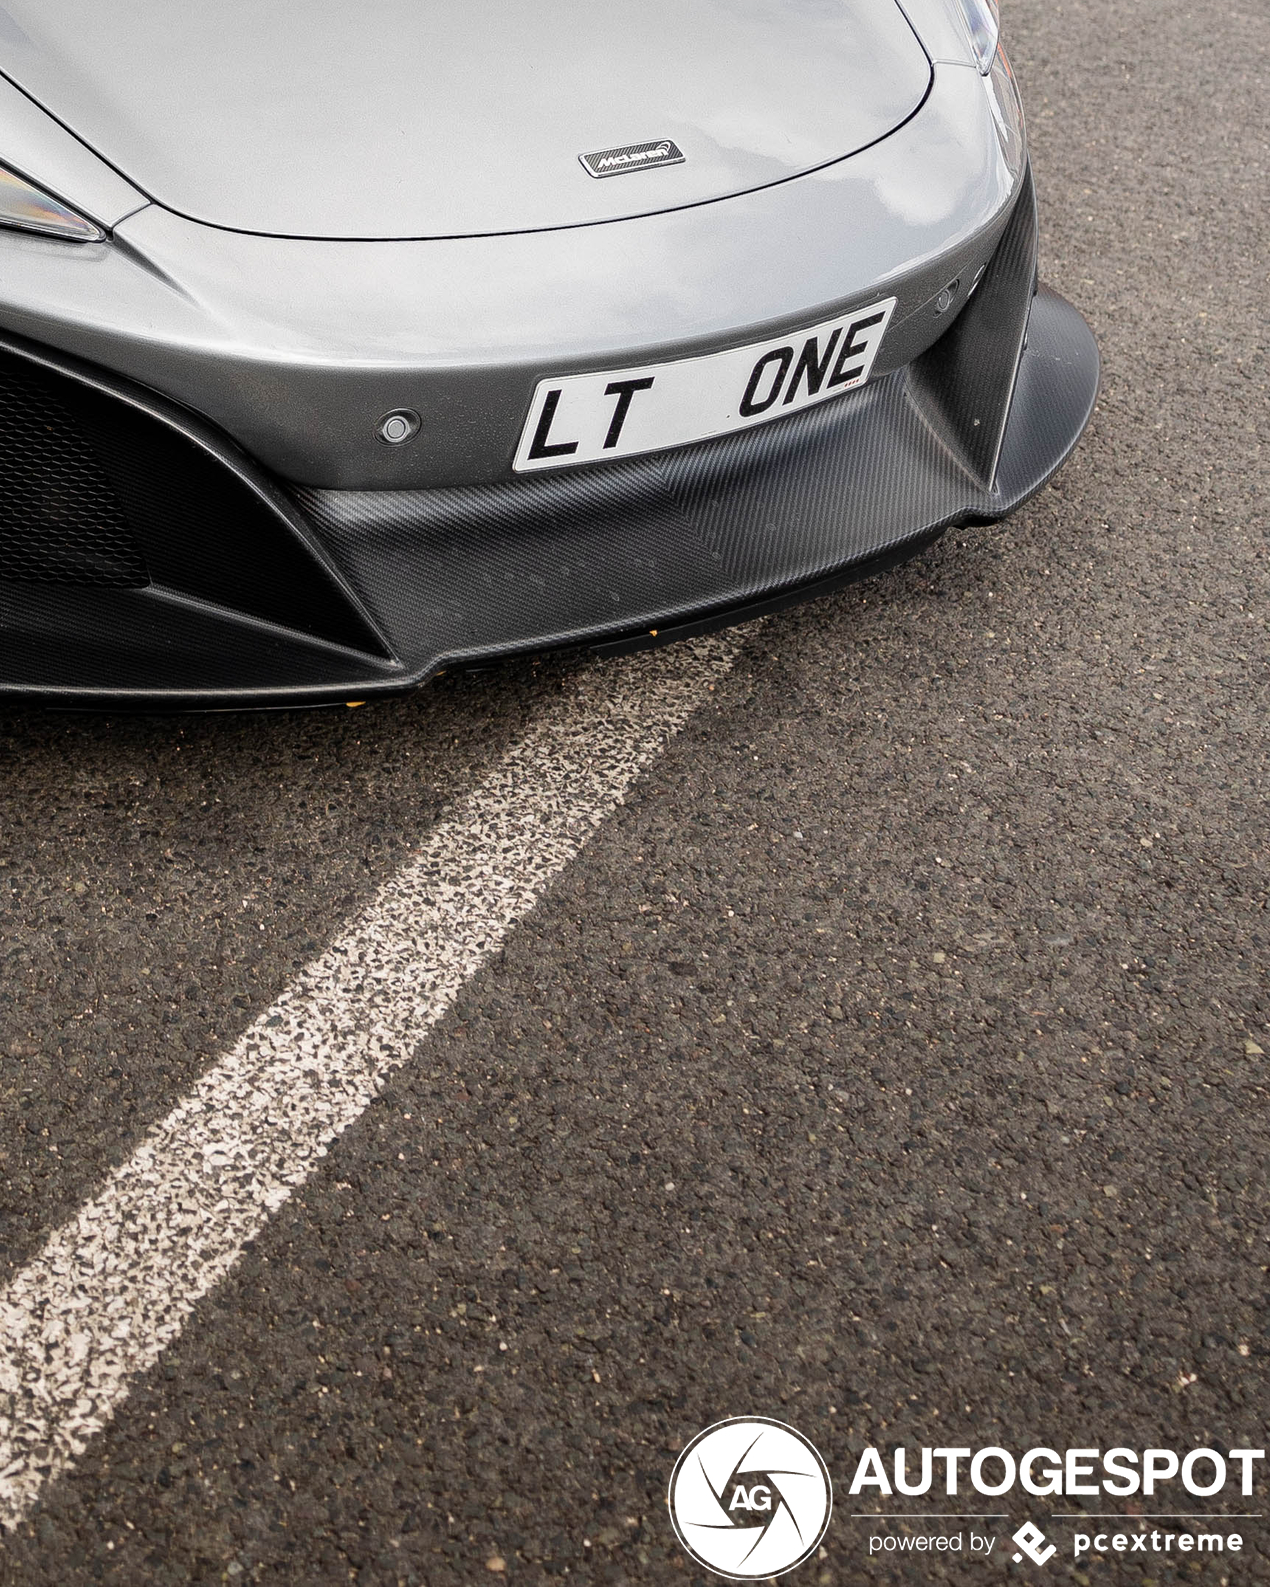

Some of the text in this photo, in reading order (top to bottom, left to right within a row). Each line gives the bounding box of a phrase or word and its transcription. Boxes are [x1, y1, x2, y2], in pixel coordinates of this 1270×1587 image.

[597, 148, 669, 169] McLaren
[527, 311, 885, 460] LT ONE
